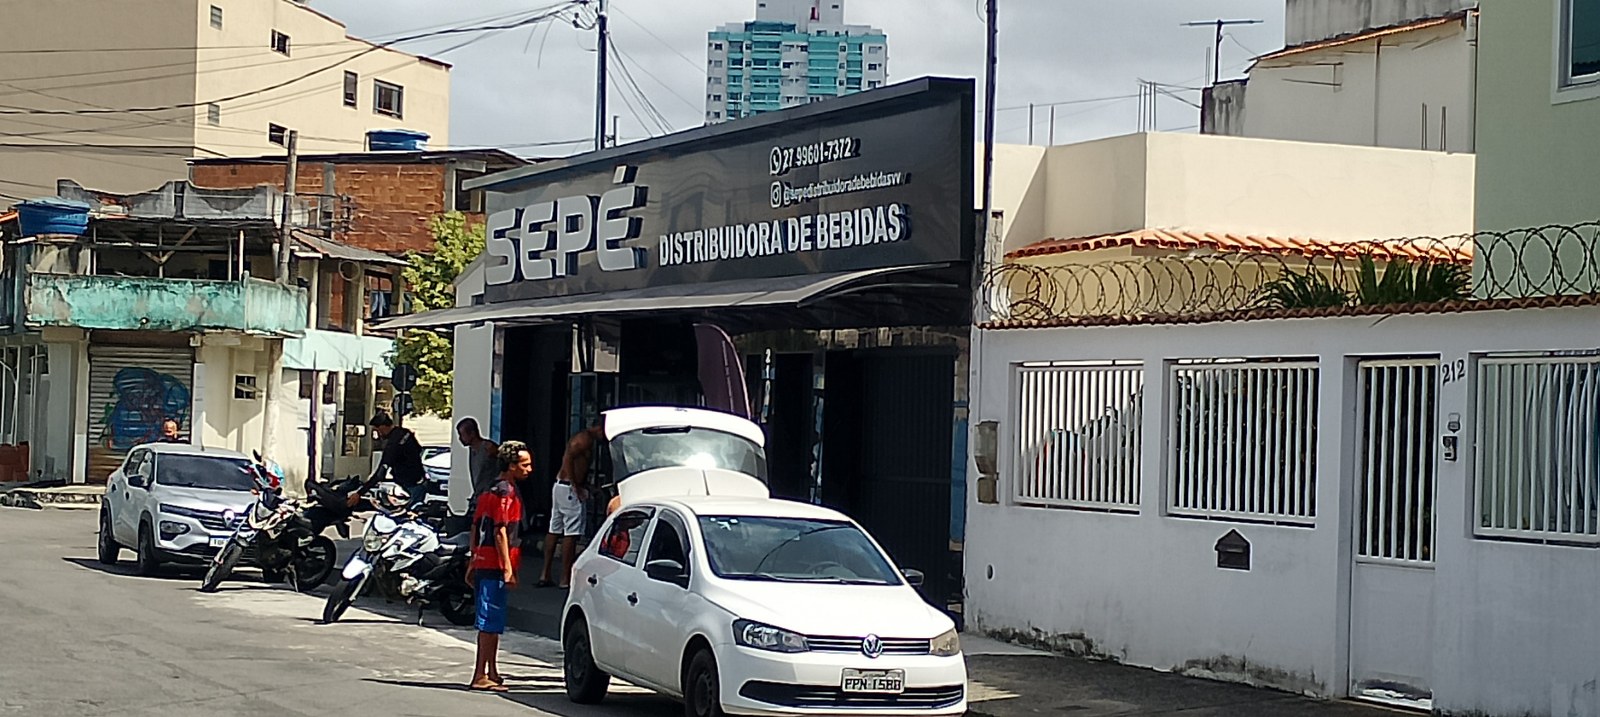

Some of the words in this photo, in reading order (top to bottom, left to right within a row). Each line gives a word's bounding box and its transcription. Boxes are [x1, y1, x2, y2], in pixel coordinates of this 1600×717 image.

[782, 148, 794, 170] 27
[795, 137, 851, 166] 99601-7372
[485, 165, 636, 286] SEPÉ
[659, 219, 784, 266] DISTRIBUIDORA
[788, 215, 811, 252] DE
[816, 203, 901, 250] BEBIDAS
[1441, 358, 1466, 387] 212
